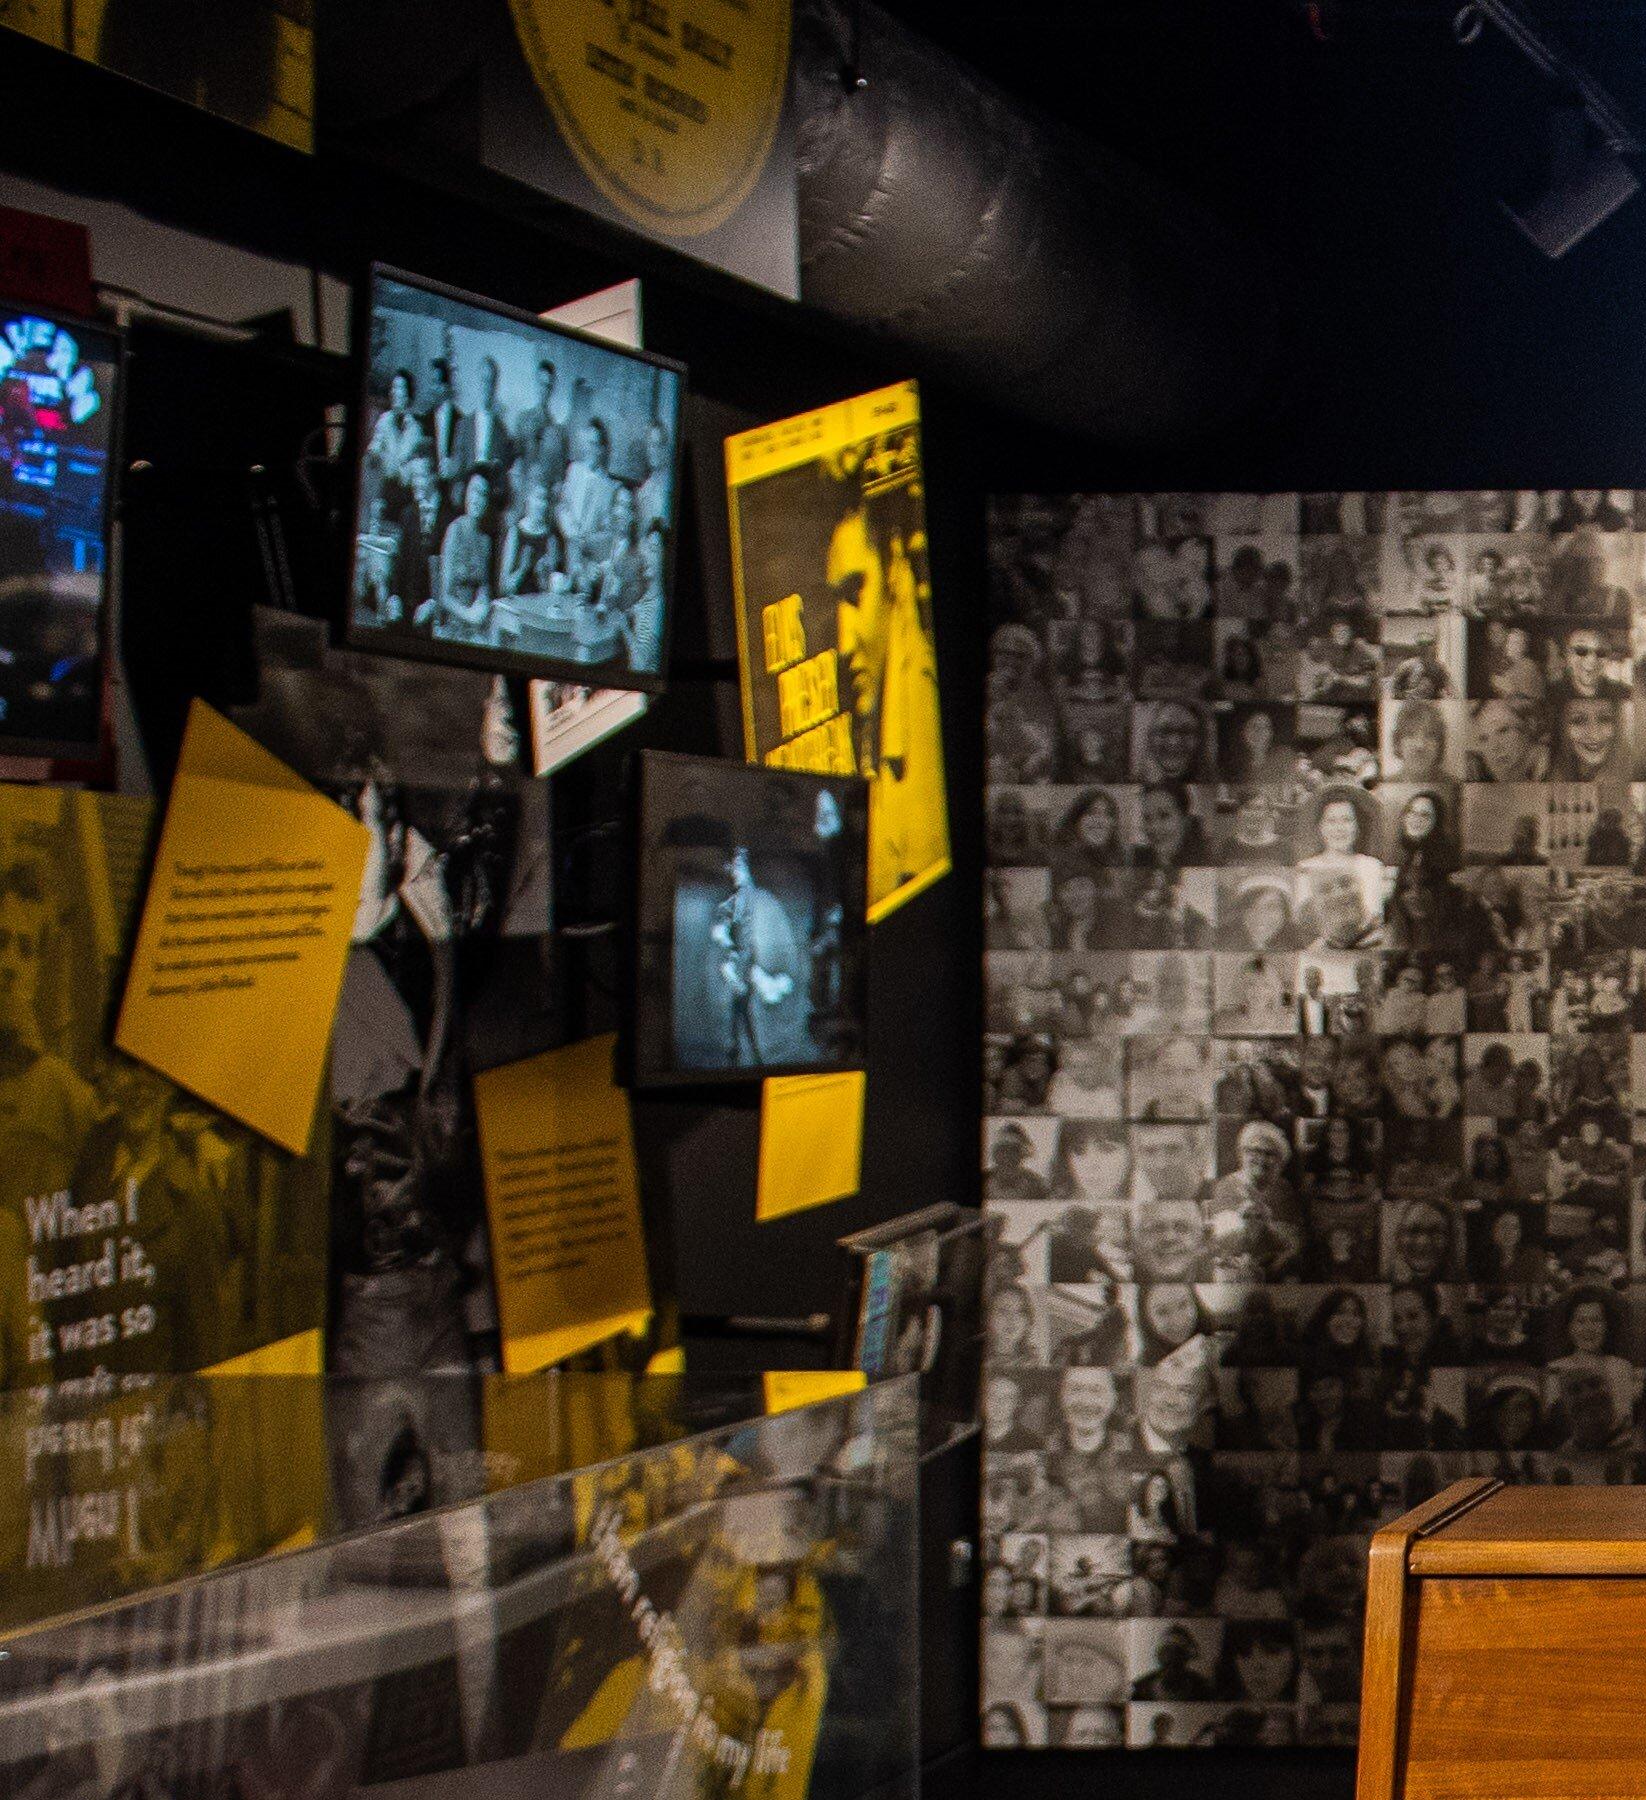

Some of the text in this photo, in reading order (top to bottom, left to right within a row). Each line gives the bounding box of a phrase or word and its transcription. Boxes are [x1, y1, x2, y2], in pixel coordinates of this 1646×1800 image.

[24, 1177, 139, 1243] When I
[26, 1237, 116, 1304] heard
[28, 1303, 156, 1363] it was so
